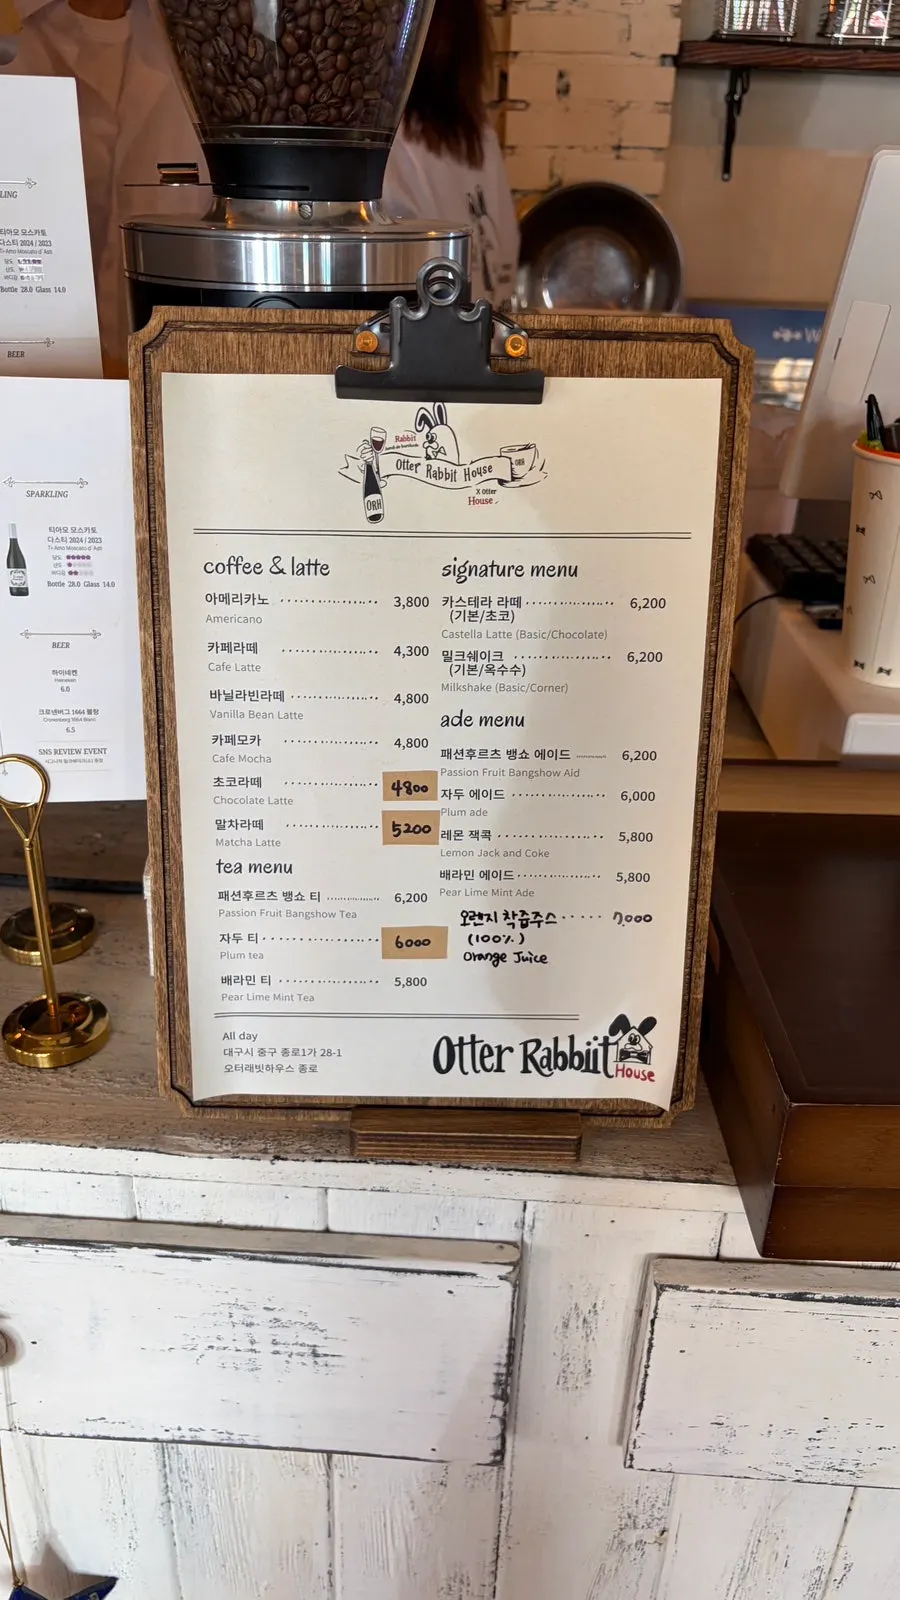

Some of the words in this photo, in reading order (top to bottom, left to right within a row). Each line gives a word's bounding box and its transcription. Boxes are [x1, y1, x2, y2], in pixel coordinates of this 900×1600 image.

[396, 458, 421, 473] Otter
[426, 463, 457, 482] Rabbit
[464, 463, 493, 482] House
[26, 490, 68, 498] SPARKLING
[468, 496, 493, 505] House
[367, 499, 382, 512] ORH
[203, 556, 263, 575] coffee
[269, 556, 286, 575] &
[291, 556, 330, 576] latte
[442, 557, 525, 584] signature
[530, 563, 578, 578] menu
[205, 592, 269, 606] 아메리카노
[394, 596, 429, 609] 3,800
[442, 596, 492, 609] 카스테라
[497, 596, 522, 609] 라떼
[630, 598, 666, 610] 6,200
[206, 614, 263, 624] Americano
[450, 610, 515, 624] (기본/초코)
[441, 629, 482, 639] Castella
[486, 630, 512, 639] Latte
[516, 629, 607, 640] (Basic/Chocolate)
[208, 641, 258, 654] 카페라떼
[394, 645, 429, 658] 4,300
[442, 650, 503, 663] 밀크쉐이크
[627, 652, 663, 664] 6,200
[208, 663, 231, 672] Cafe
[235, 663, 261, 672] Latte
[449, 663, 526, 677] (기본/옥수수)
[441, 683, 492, 692] Milkshake
[495, 683, 568, 693] (Basic/Corner)
[210, 689, 285, 702] 바닐라빈라떼
[394, 693, 429, 706] 4,800
[210, 710, 245, 719] Vanilla
[249, 710, 274, 719] Bean
[278, 711, 303, 720] Latte
[440, 709, 473, 728] ade
[479, 715, 525, 728] menu
[212, 734, 261, 747] 카페모카
[394, 738, 429, 750] 4,800
[212, 754, 235, 763] Cafe
[238, 754, 271, 764] Mocha
[440, 749, 501, 761] 패션후르츠
[506, 749, 529, 761] 뱅쇼
[534, 749, 571, 761] 에이드
[622, 750, 657, 763] 6,200
[441, 768, 479, 777] Passion
[482, 768, 505, 777] Fruit
[508, 768, 561, 779] Bangshow
[564, 768, 580, 777] Aid
[212, 776, 262, 788] 초코라떼
[391, 780, 429, 797] 4800
[213, 795, 264, 805] Chocolate
[268, 797, 294, 806] Latte
[440, 789, 465, 801] 자두
[469, 789, 505, 801] 에이드
[621, 791, 655, 803] 6,000
[440, 808, 466, 817] Plum
[469, 808, 488, 817] ade
[215, 818, 264, 831] 말차라떼
[392, 821, 432, 837] 5200
[215, 838, 252, 847] Matcha
[255, 838, 281, 847] Latte
[441, 830, 464, 841] 레몬
[468, 830, 492, 842] 잭콕
[618, 832, 653, 844] 5,800
[440, 849, 474, 858] Lemon
[477, 849, 500, 858] Jack
[503, 849, 522, 858] and
[525, 849, 550, 858] Coke
[216, 859, 242, 874] tea
[248, 862, 293, 875] menu
[440, 870, 475, 881] 배라민
[479, 870, 514, 881] 에이드
[616, 873, 650, 885] 5,800
[218, 890, 278, 902] 패션후르츠
[282, 891, 305, 902] 뱅쇼
[310, 891, 321, 902] 티
[394, 893, 428, 904] 6,200
[439, 888, 462, 897] Pear
[465, 888, 488, 897] Lime
[492, 888, 513, 897] Mint
[515, 889, 534, 897] Ade
[218, 909, 257, 918] Passion
[260, 909, 282, 918] Fruit
[285, 909, 336, 920] Bangshow
[339, 910, 357, 919] Tea
[460, 909, 498, 927] 오렌지
[219, 933, 243, 944] 자두
[248, 933, 258, 943] 티
[395, 935, 431, 948] 6000
[220, 951, 245, 960] Plum
[248, 952, 264, 960] tea
[463, 951, 507, 967] Orange
[513, 952, 548, 964] Juice
[221, 975, 256, 986] 배라민
[260, 975, 271, 986] 티
[394, 977, 427, 988] 5,800
[221, 993, 243, 1002] Pear
[246, 993, 270, 1002] Lime
[273, 993, 294, 1002] Mint
[297, 994, 314, 1002] Tea
[223, 1032, 235, 1041] All
[239, 1032, 258, 1043] day
[223, 1048, 253, 1057] 대구시
[258, 1048, 277, 1057] 중구
[281, 1048, 318, 1057] 종로1가
[320, 1048, 342, 1057] 28-1
[433, 1034, 514, 1075] Otter
[224, 1064, 295, 1073] 오터래빗하우스
[299, 1064, 318, 1073] 종로
[615, 1065, 655, 1082] House
